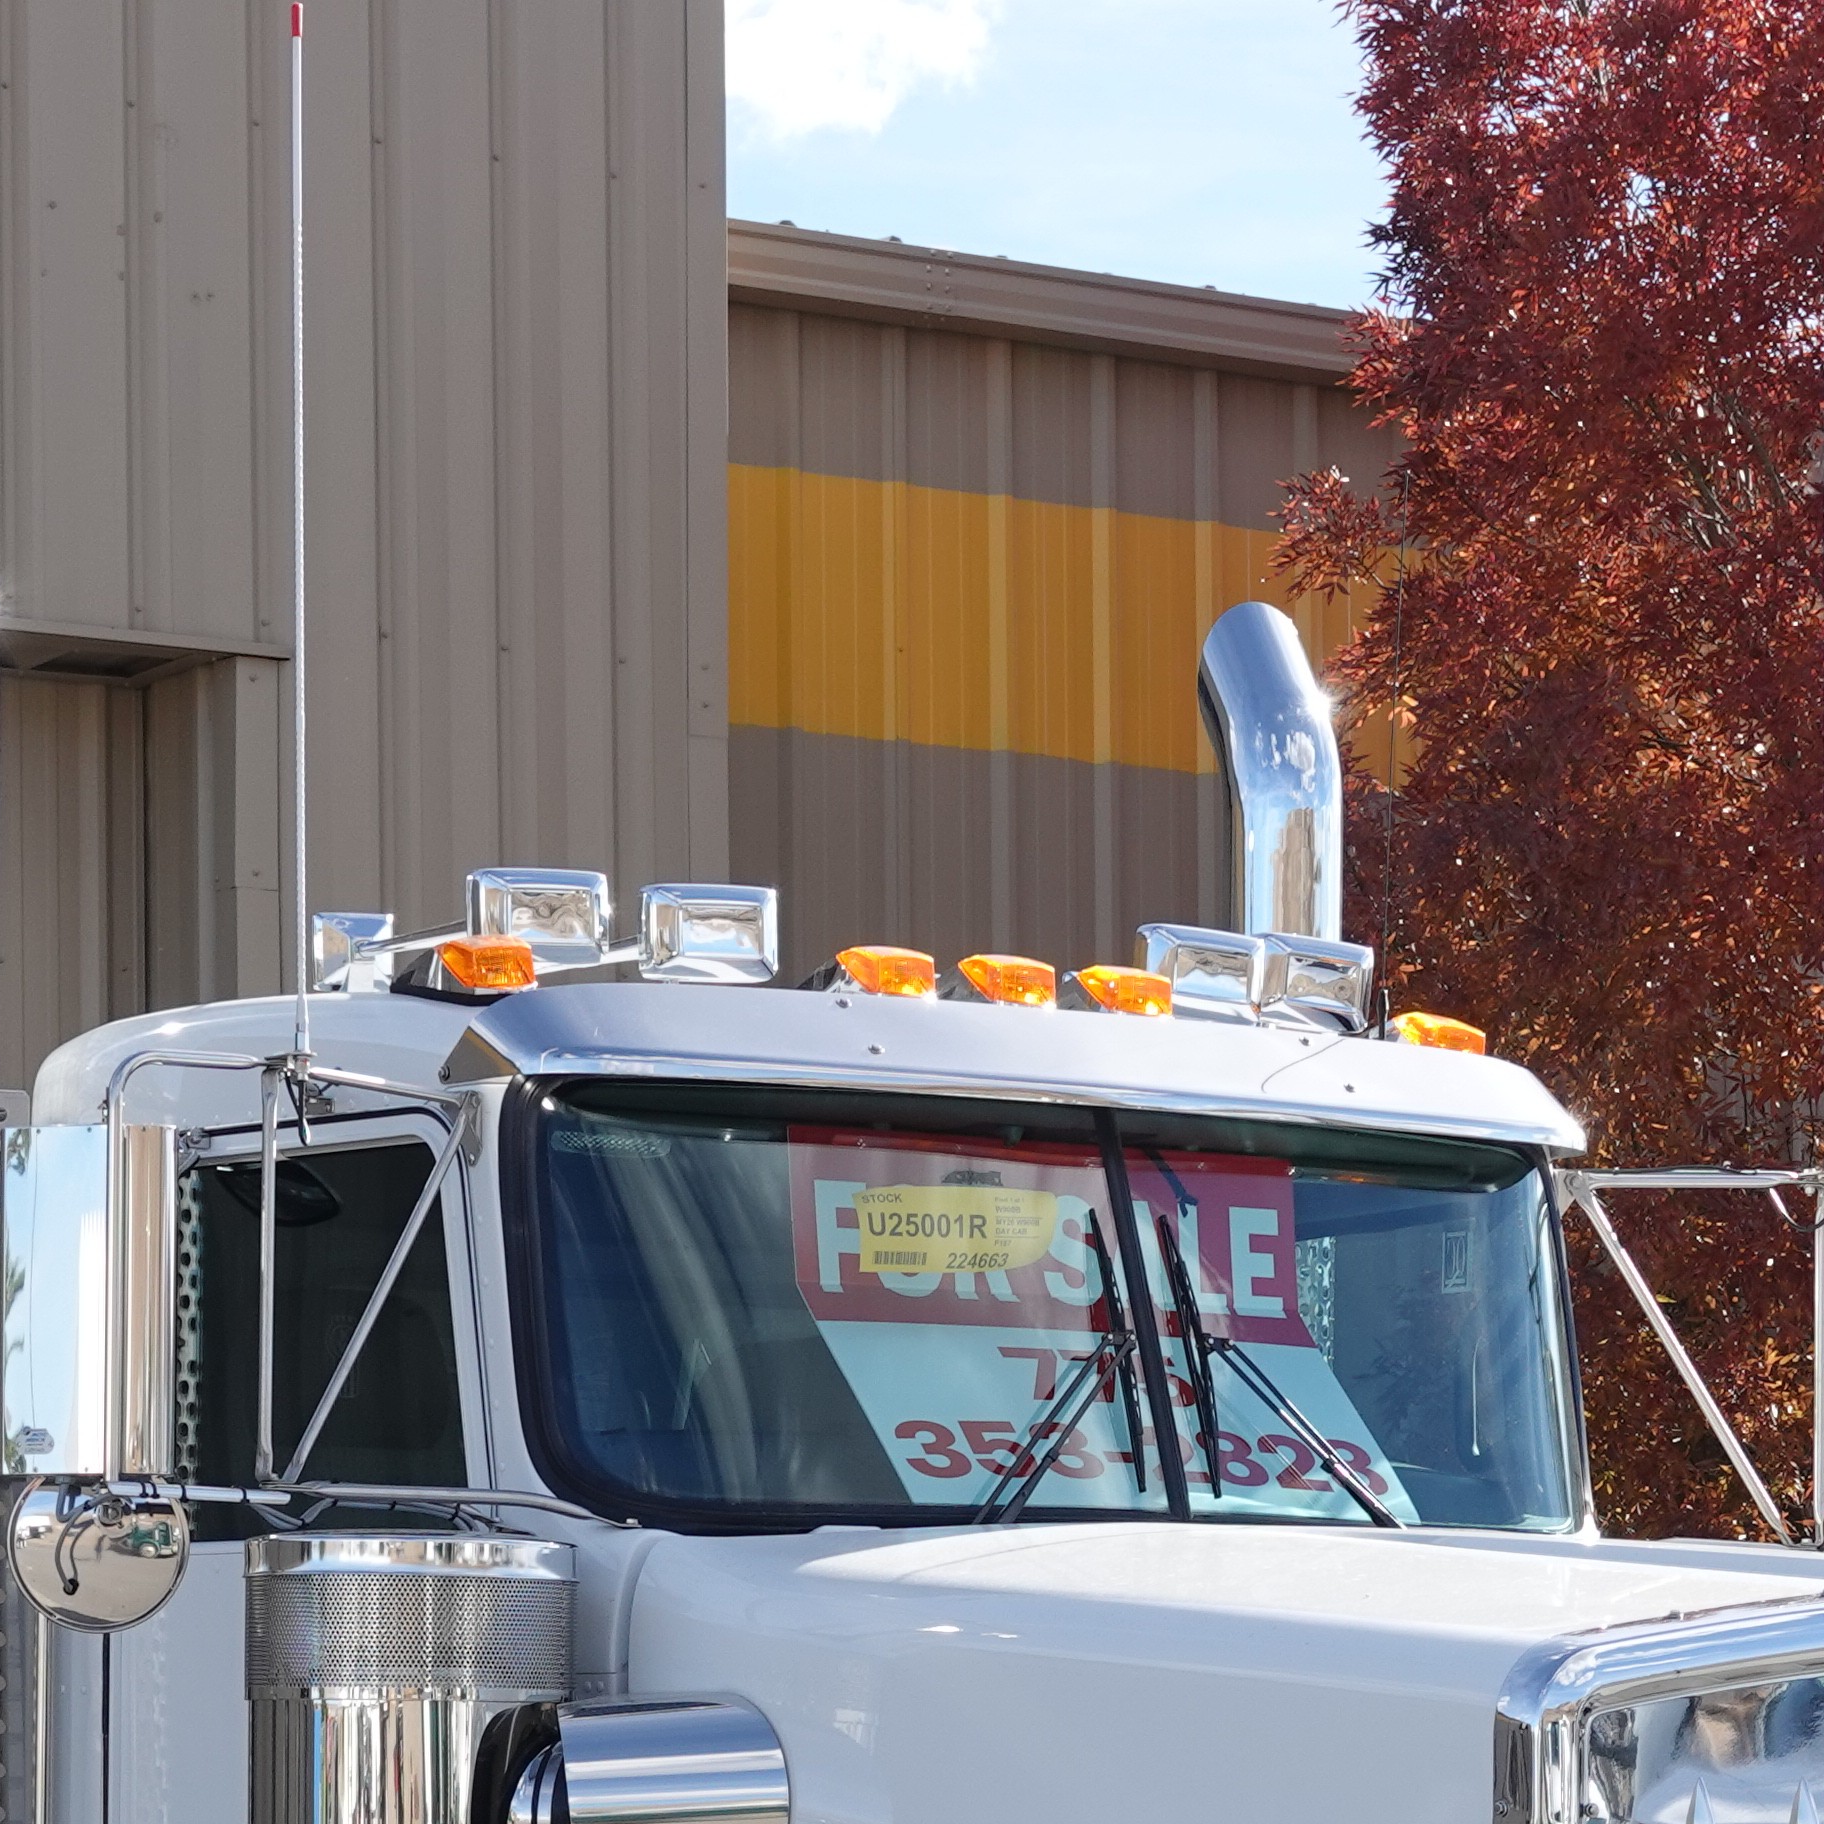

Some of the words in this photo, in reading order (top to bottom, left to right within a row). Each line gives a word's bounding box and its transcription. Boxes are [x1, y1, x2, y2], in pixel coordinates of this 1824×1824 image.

[861, 1193, 903, 1204] STOCK
[867, 1211, 987, 1239] U25001R
[945, 1252, 1010, 1270] 224663
